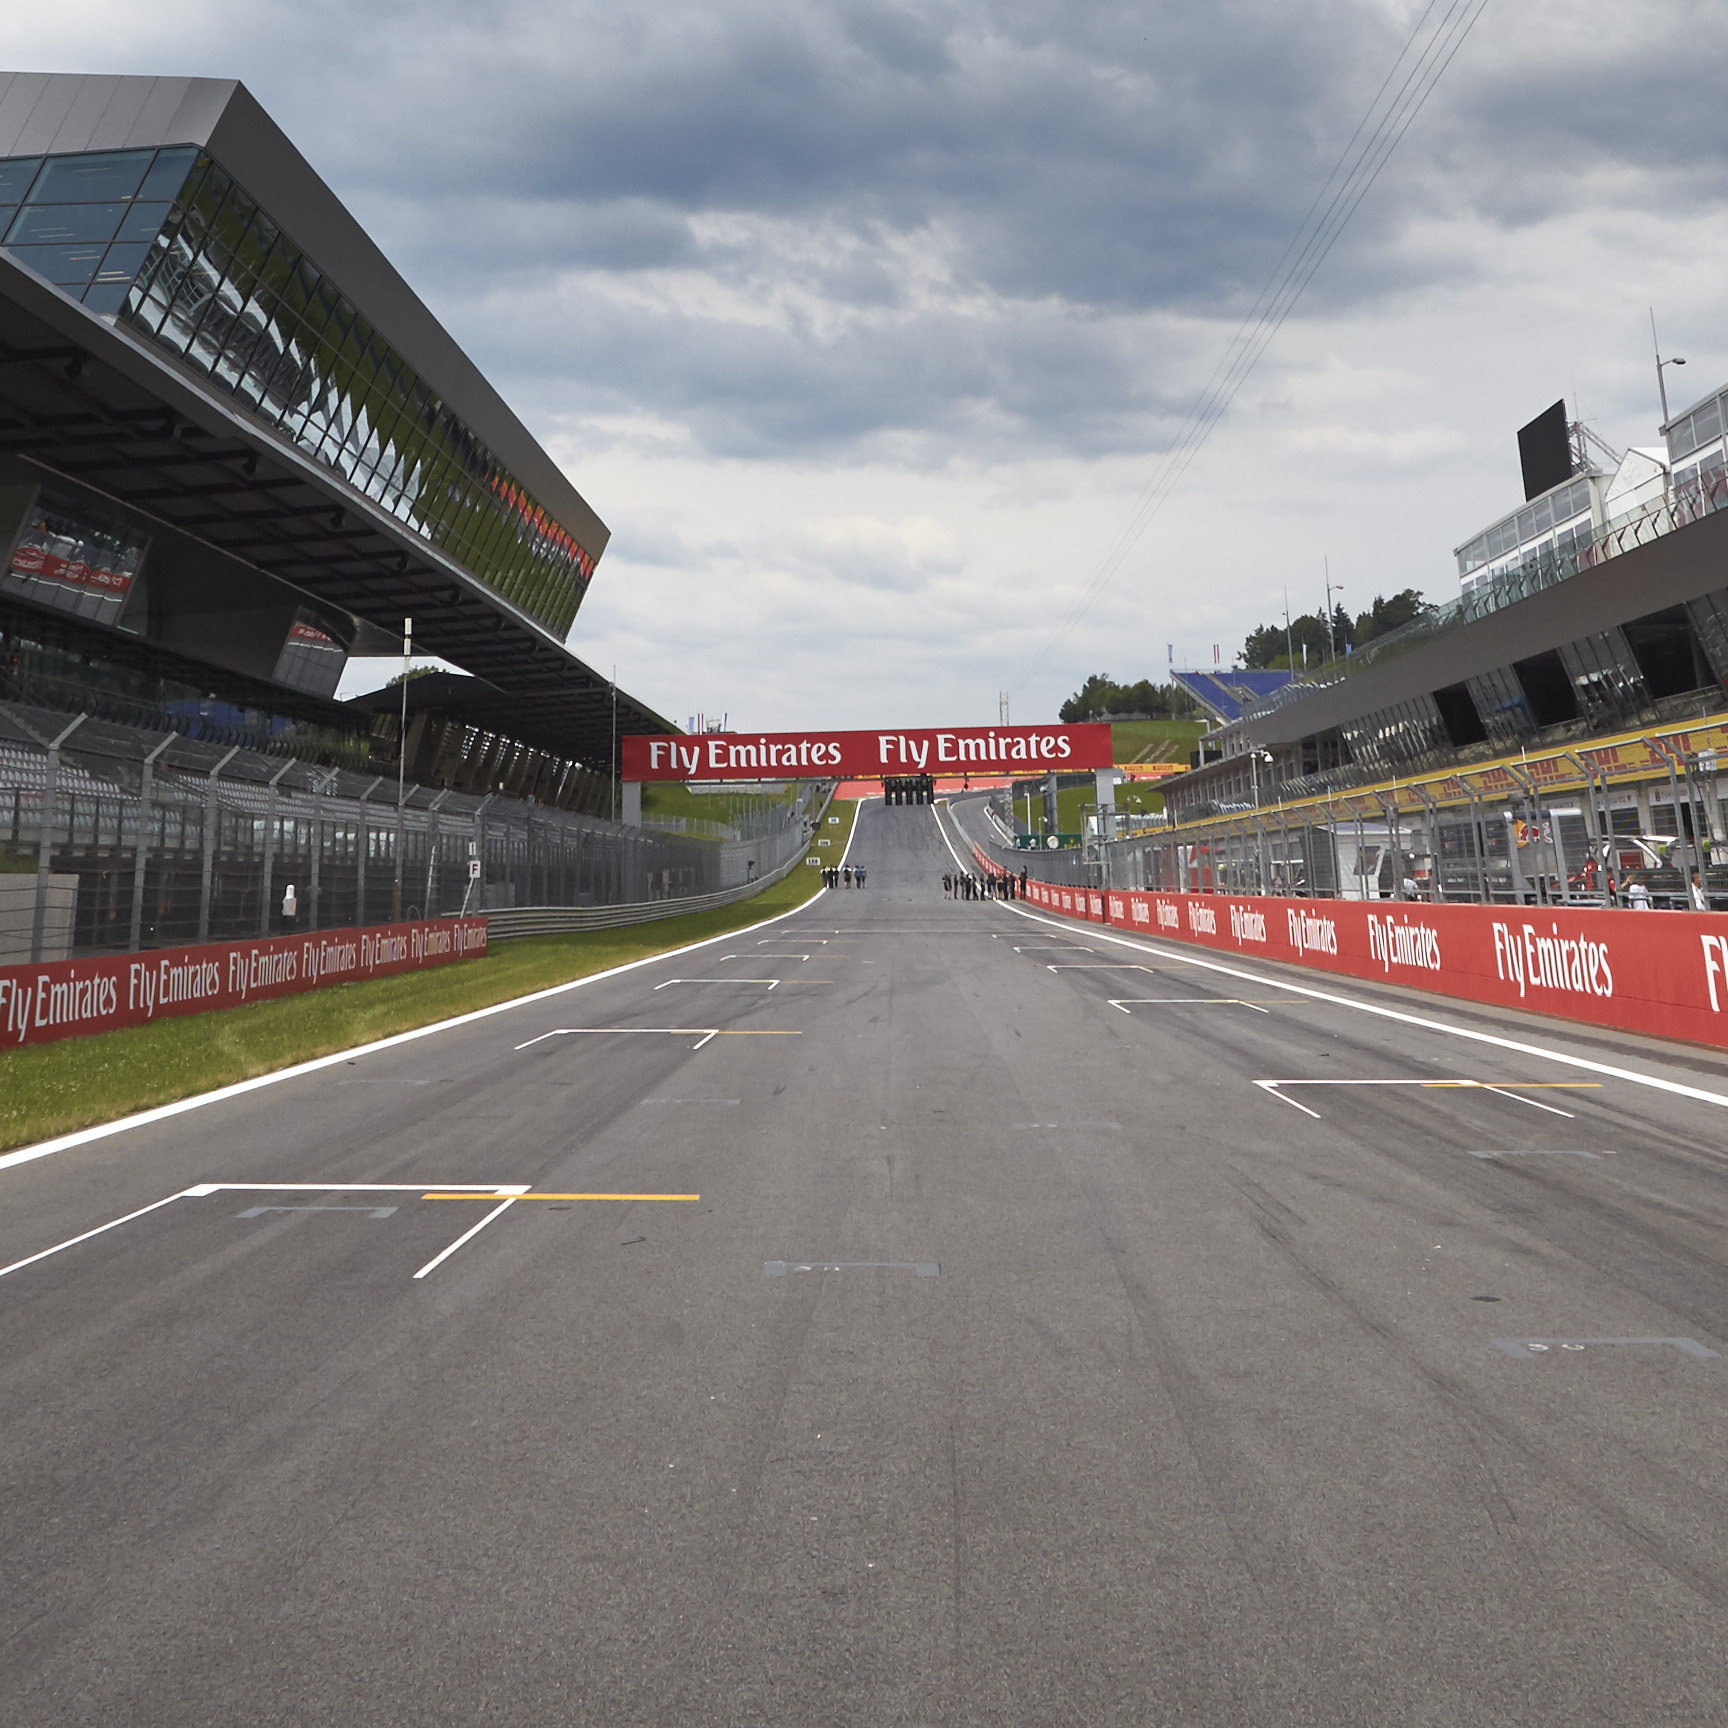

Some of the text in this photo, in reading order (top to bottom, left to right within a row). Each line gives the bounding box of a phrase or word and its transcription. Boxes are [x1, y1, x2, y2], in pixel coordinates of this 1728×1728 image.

[649, 738, 842, 775] Fly Emirates
[878, 731, 1071, 769] Fly Emirates
[302, 937, 356, 984] Fly Emirates
[1287, 908, 1303, 957] Fly
[1367, 914, 1441, 973] Fly Emirates
[1492, 922, 1613, 998] Fly Emirates
[34, 969, 117, 1028] Emirates
[128, 957, 220, 1017] Fly Emirates
[228, 945, 298, 1001] Fly Emirates
